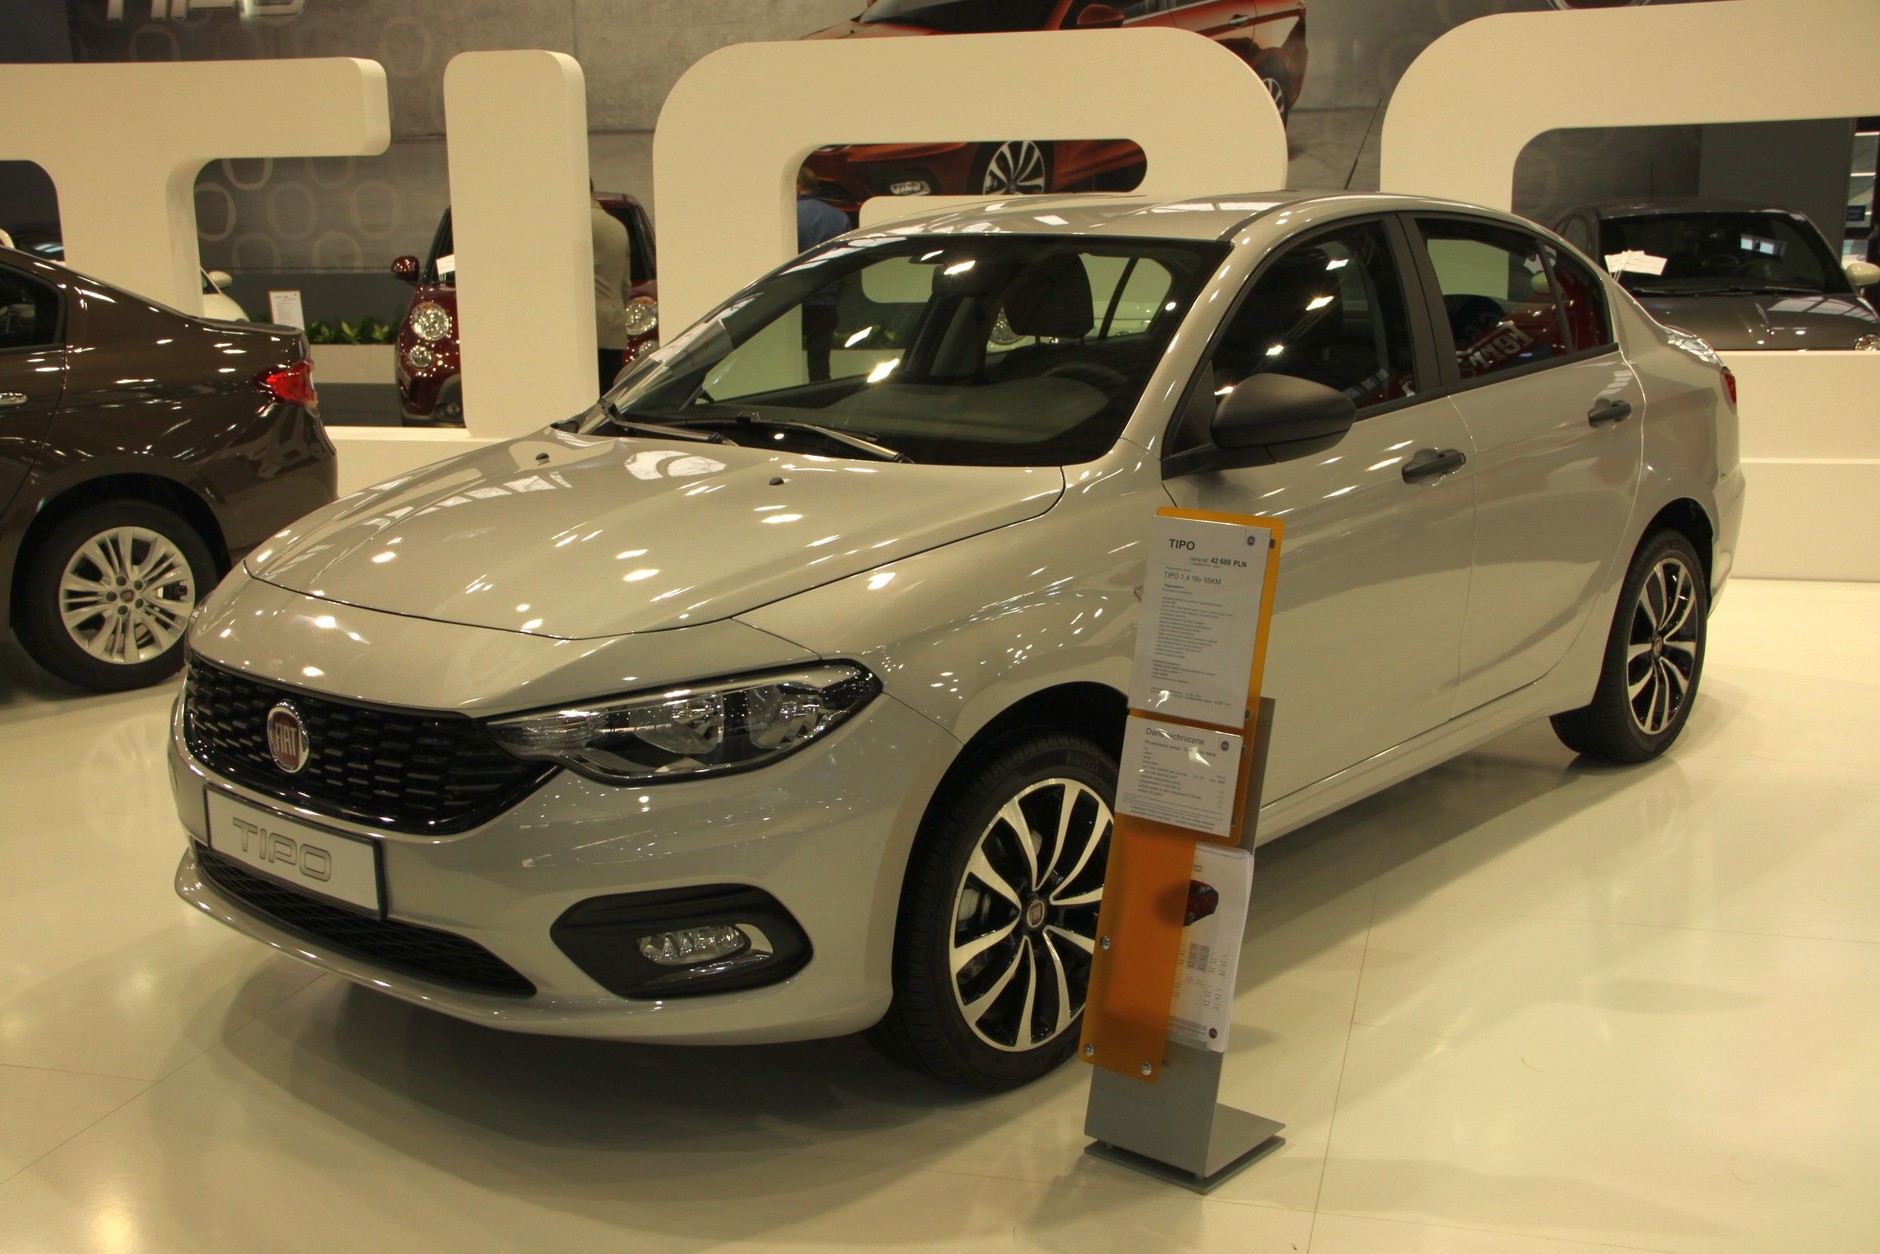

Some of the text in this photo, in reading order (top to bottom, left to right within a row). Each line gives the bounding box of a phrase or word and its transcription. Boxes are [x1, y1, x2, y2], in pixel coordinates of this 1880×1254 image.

[1169, 539, 1195, 551] TIPO
[1211, 557, 1219, 565] 42
[1220, 558, 1232, 566] 600
[1233, 560, 1247, 568] PLN
[1164, 571, 1180, 580] TIPO
[275, 722, 297, 756] FIAT
[1167, 733, 1205, 746] echniczne
[232, 817, 332, 882] TIPO
